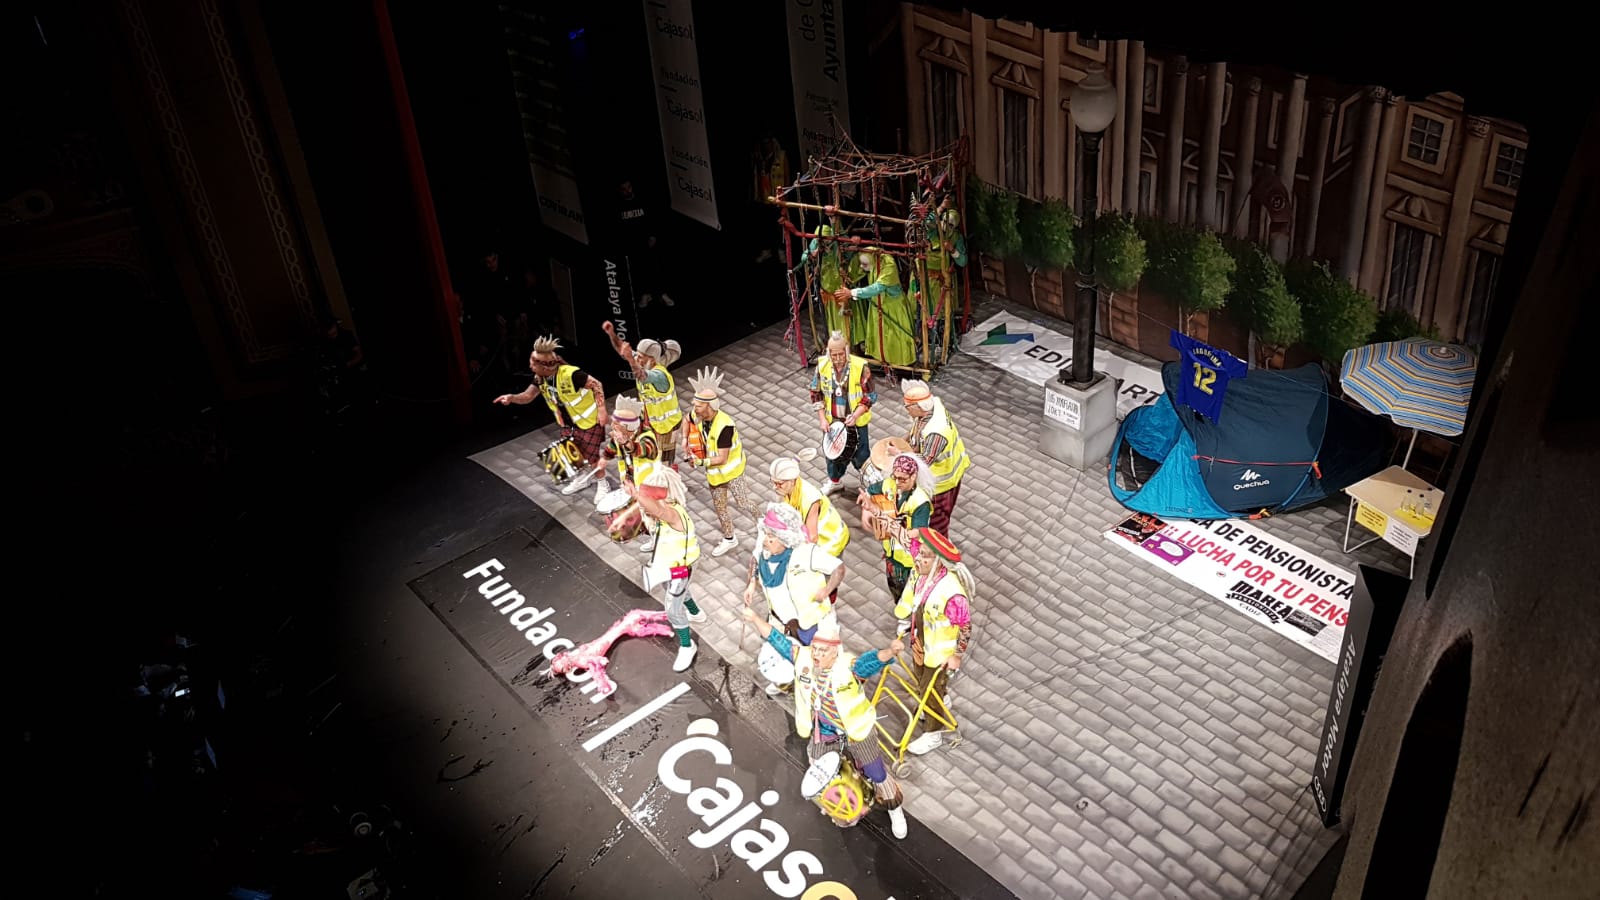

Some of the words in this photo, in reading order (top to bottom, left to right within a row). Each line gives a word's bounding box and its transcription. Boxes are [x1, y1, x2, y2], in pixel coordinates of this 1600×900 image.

[655, 16, 693, 40] Cajasol
[667, 99, 704, 124] Cajasol
[678, 176, 713, 202] Cajasol
[603, 259, 622, 315] Atalaya
[1193, 362, 1217, 395] 12
[1233, 479, 1270, 491] Quechua
[1213, 522, 1245, 542] DE
[1232, 559, 1276, 587] POR
[1273, 578, 1305, 600] TU
[1230, 579, 1294, 619] MAREA
[1333, 633, 1357, 717] Atalaya
[1321, 714, 1340, 780] Motor
